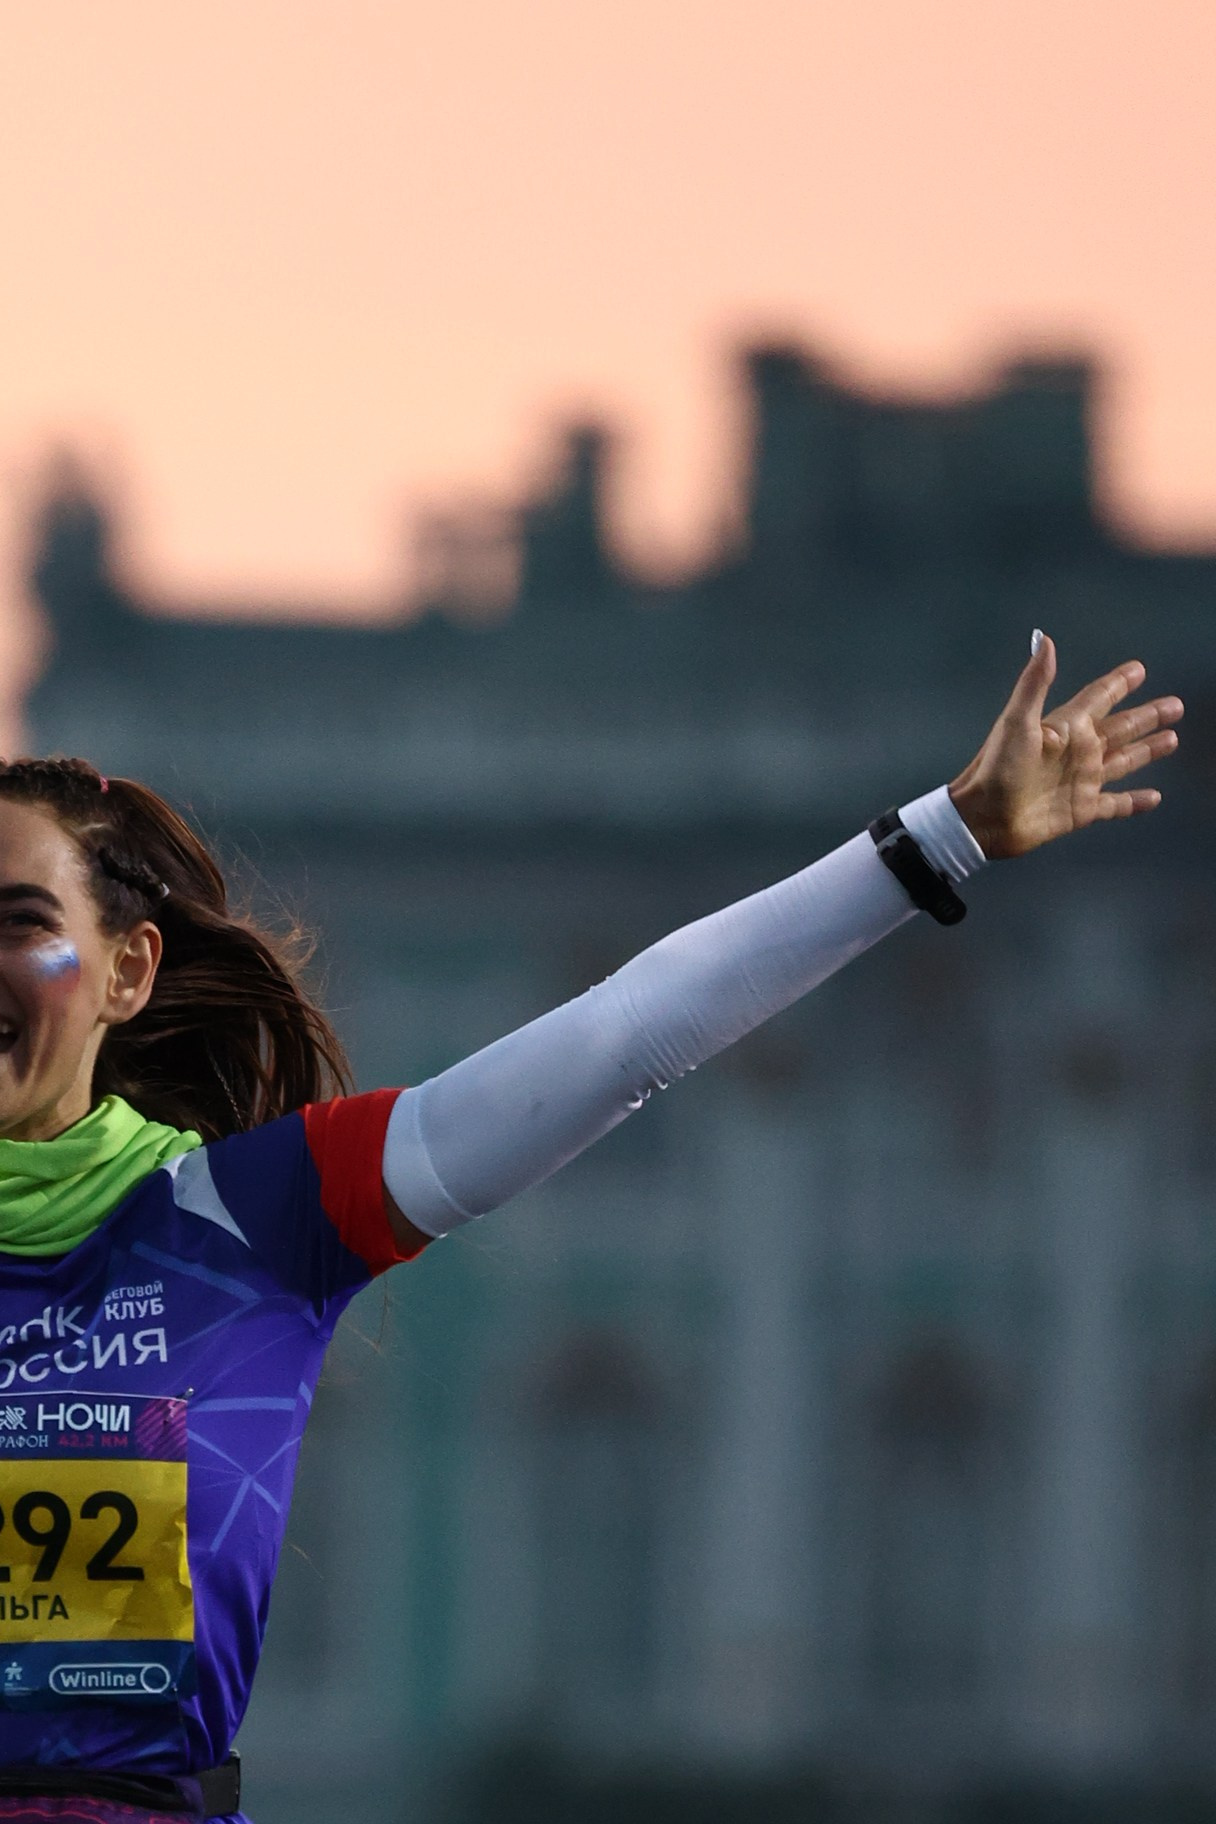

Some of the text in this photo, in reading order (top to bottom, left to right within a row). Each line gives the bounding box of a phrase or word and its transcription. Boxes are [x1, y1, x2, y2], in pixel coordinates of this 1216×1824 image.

[104, 1298, 164, 1321] КЛУБ
[37, 1403, 130, 1432] НОЧИ
[60, 1670, 137, 1688] Winline
